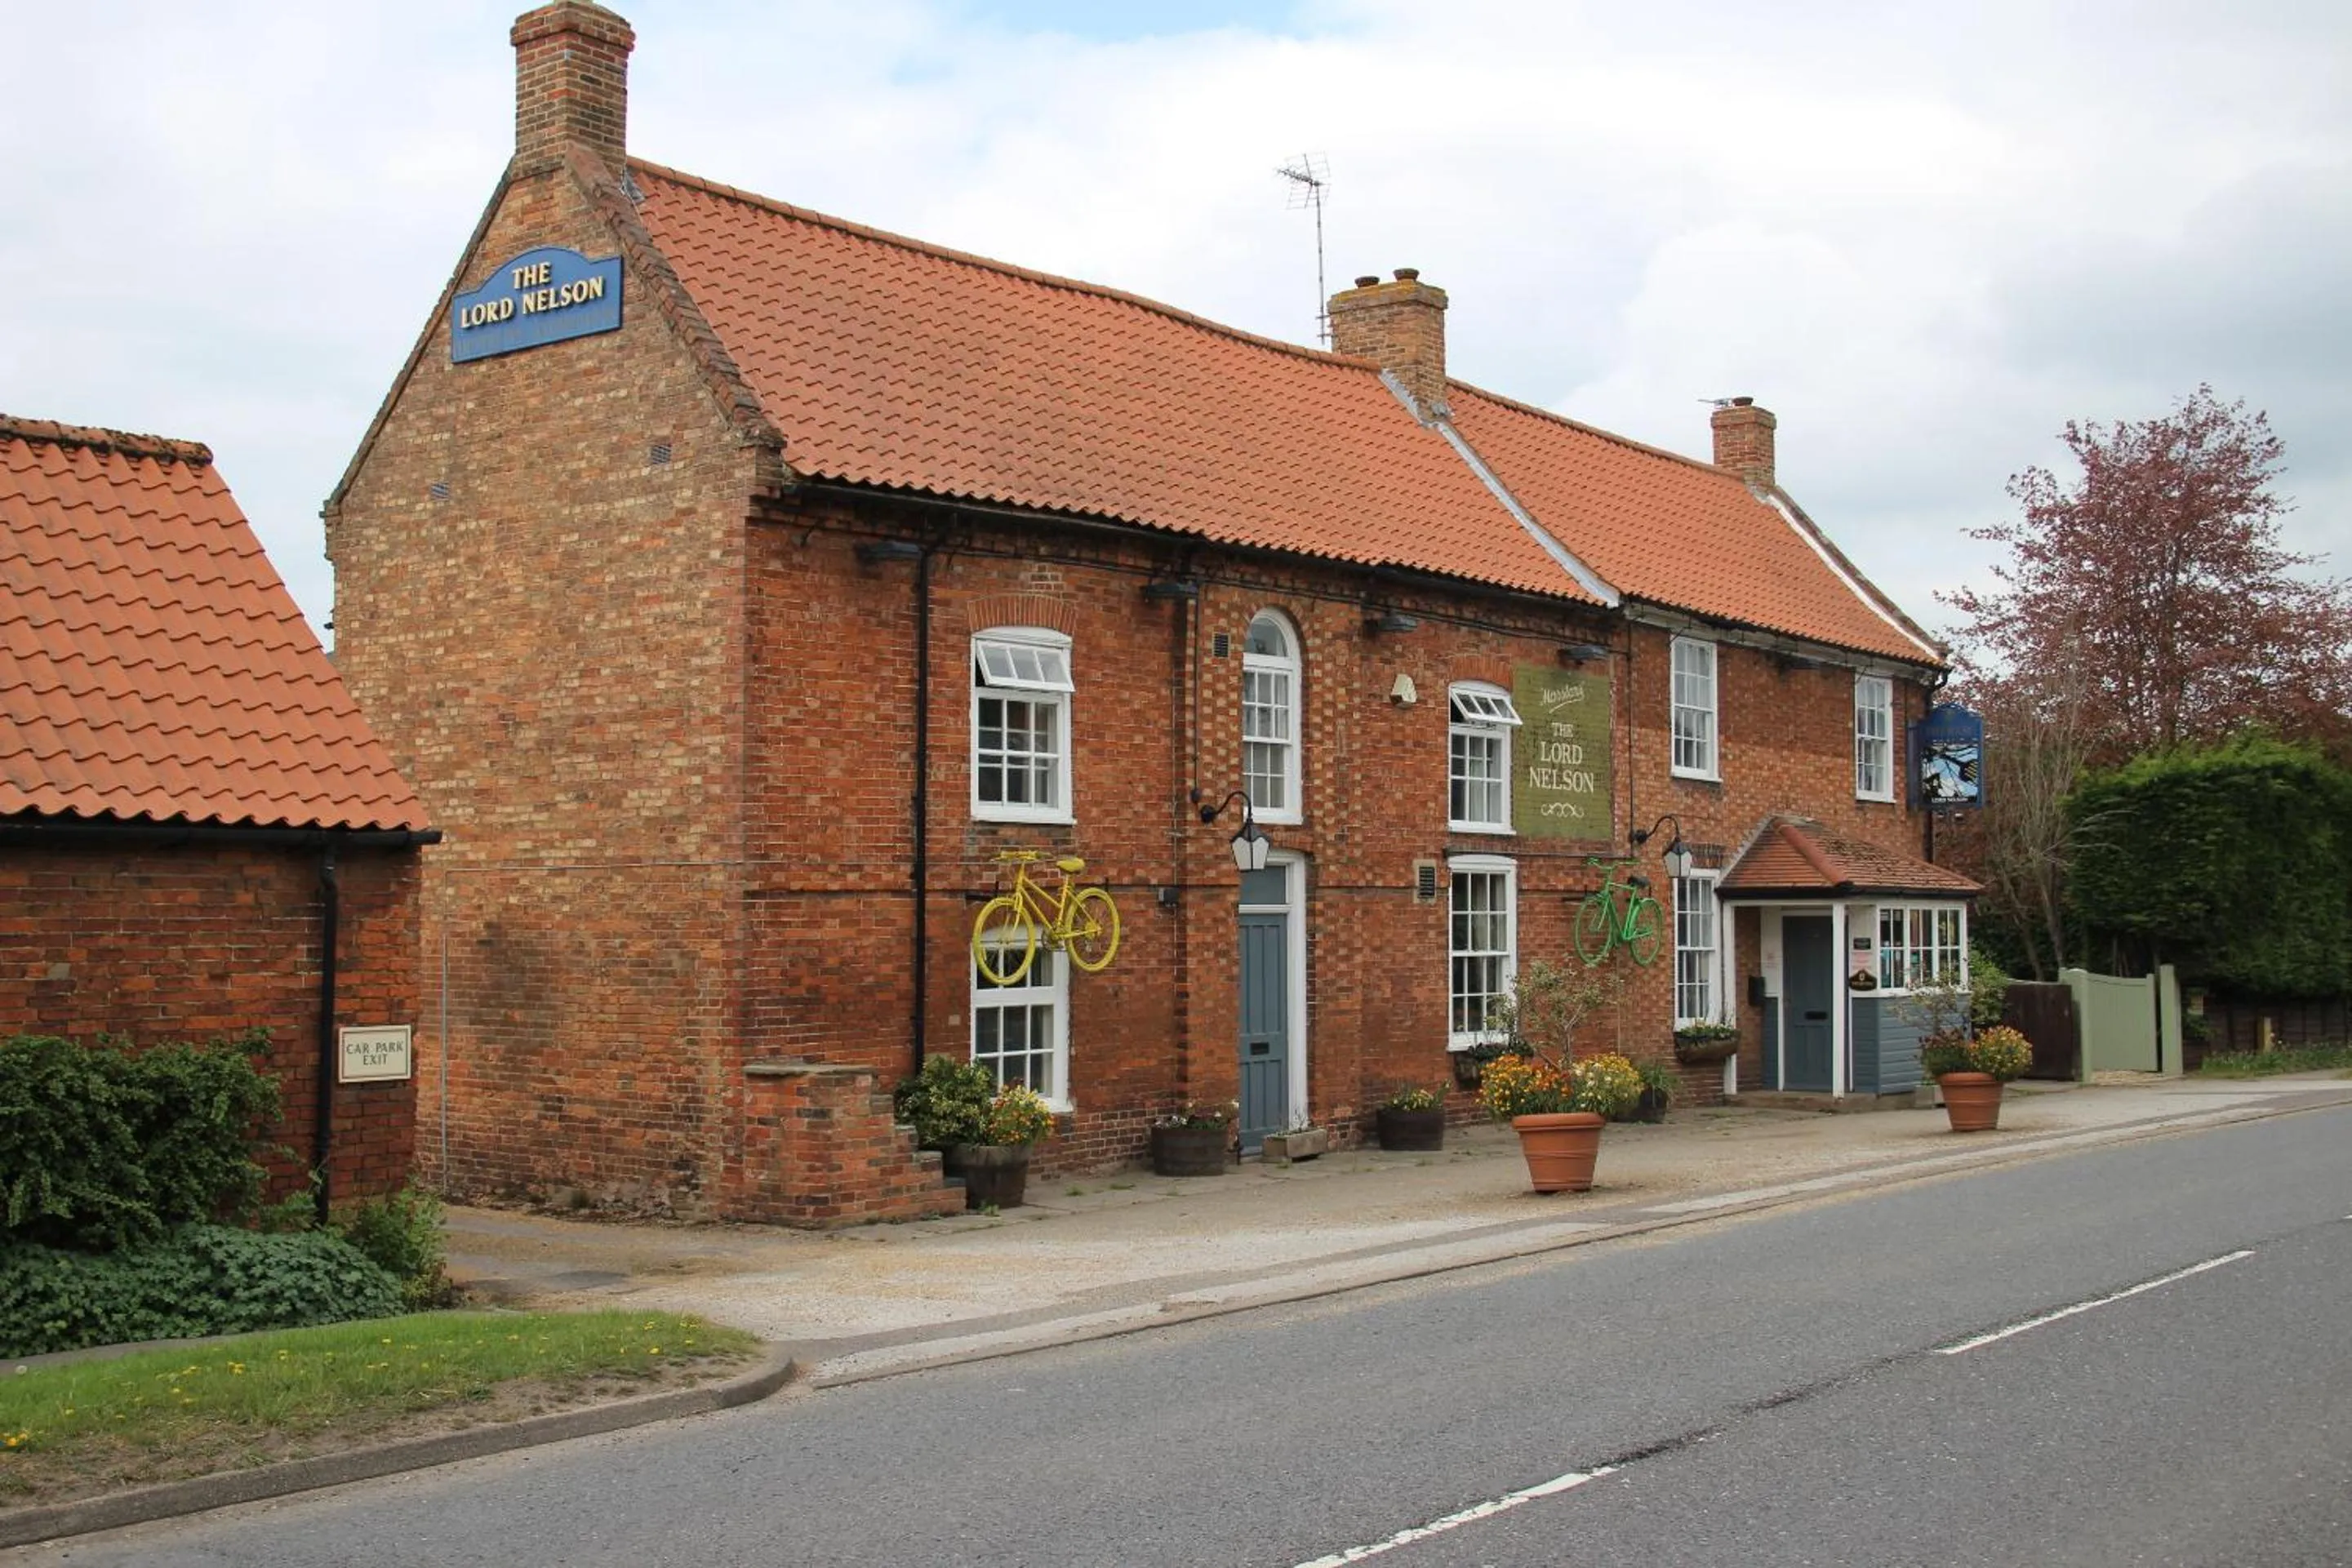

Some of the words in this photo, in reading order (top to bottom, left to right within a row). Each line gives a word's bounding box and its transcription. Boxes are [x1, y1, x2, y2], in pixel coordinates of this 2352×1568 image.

[512, 261, 552, 290] THE
[460, 296, 514, 329] LORD
[522, 276, 603, 314] NELSON
[1551, 722, 1573, 737] THE
[1541, 741, 1583, 765] LORD
[1529, 766, 1594, 794] NELSON
[346, 1042, 369, 1054] CAR
[376, 1041, 403, 1052] PARK
[363, 1054, 387, 1065] EXIT
